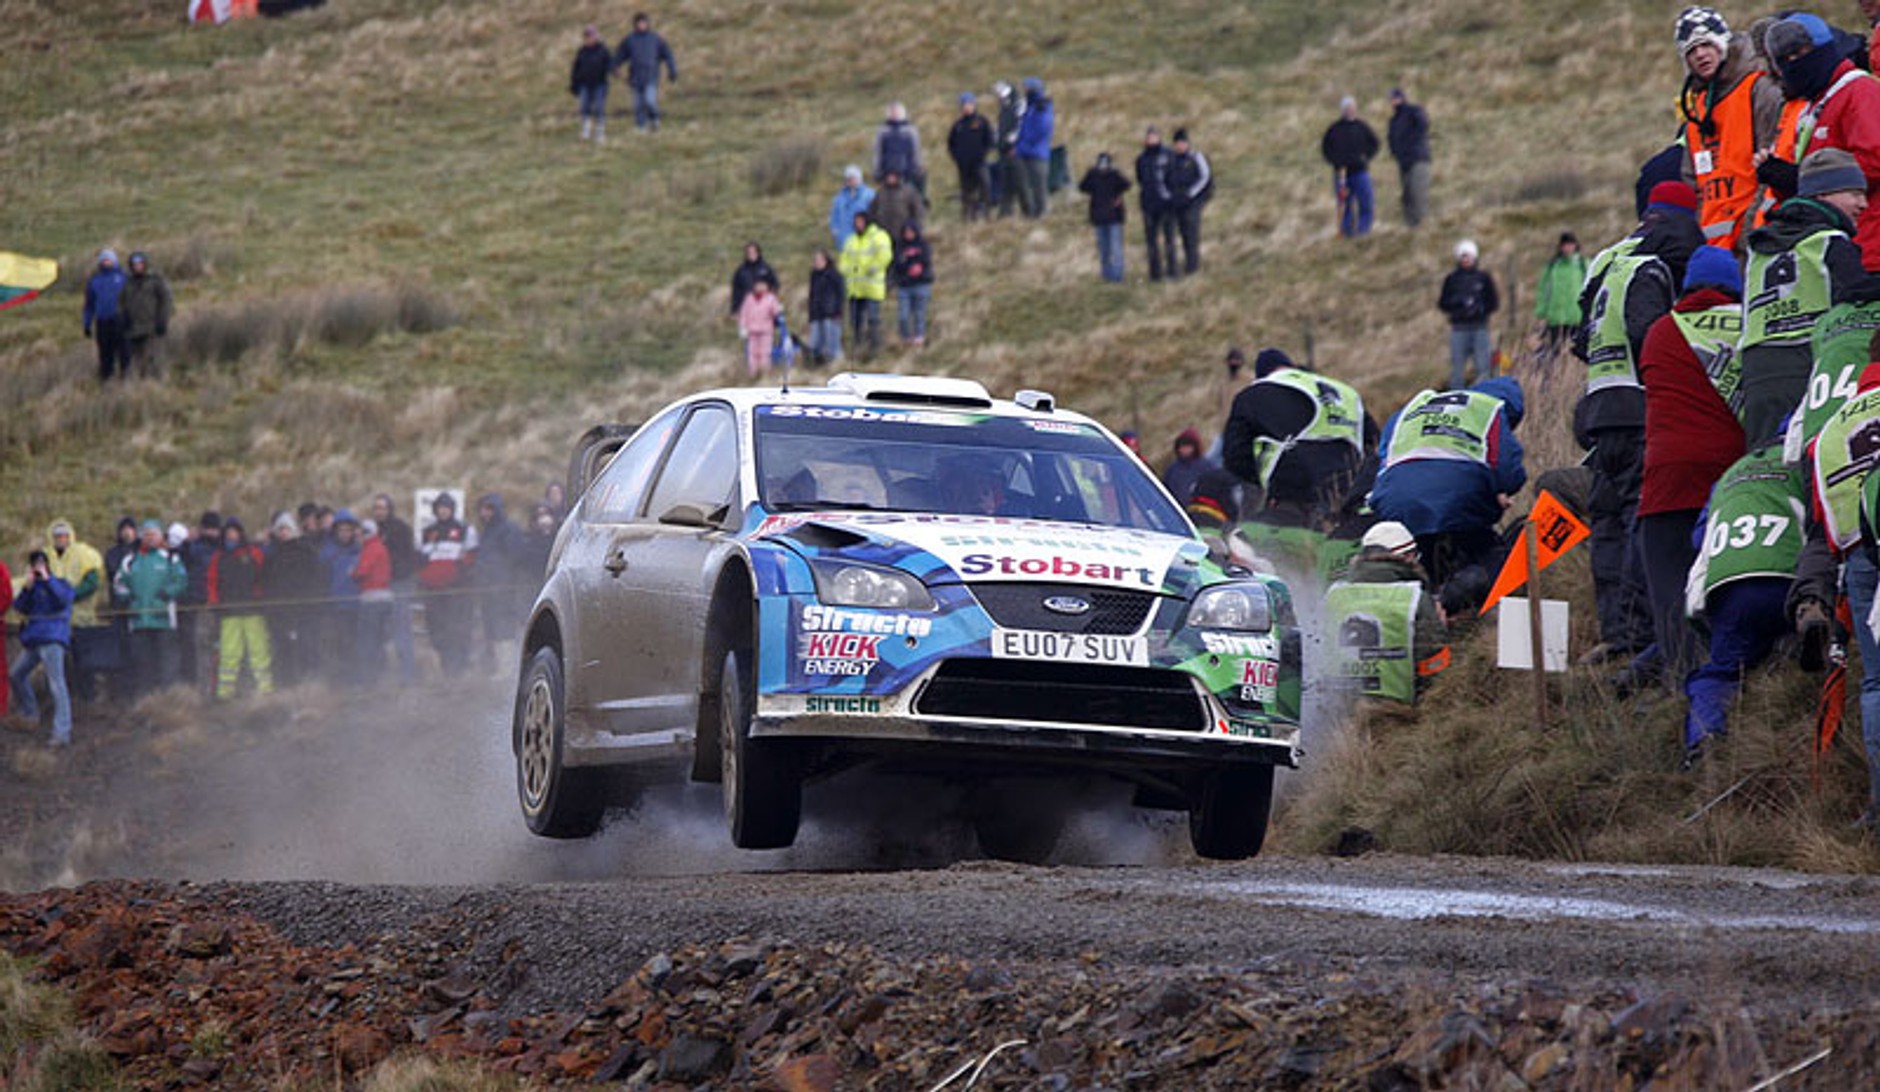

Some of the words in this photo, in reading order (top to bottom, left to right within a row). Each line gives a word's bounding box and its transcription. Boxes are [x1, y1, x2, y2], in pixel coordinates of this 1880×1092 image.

[771, 405, 932, 423] Stobar
[961, 554, 1155, 586] Stobart
[802, 605, 932, 637] Structa
[806, 633, 882, 660] KICK
[1004, 632, 1076, 658] EU07
[1083, 636, 1135, 662] SUV
[804, 659, 877, 676] ENERGY
